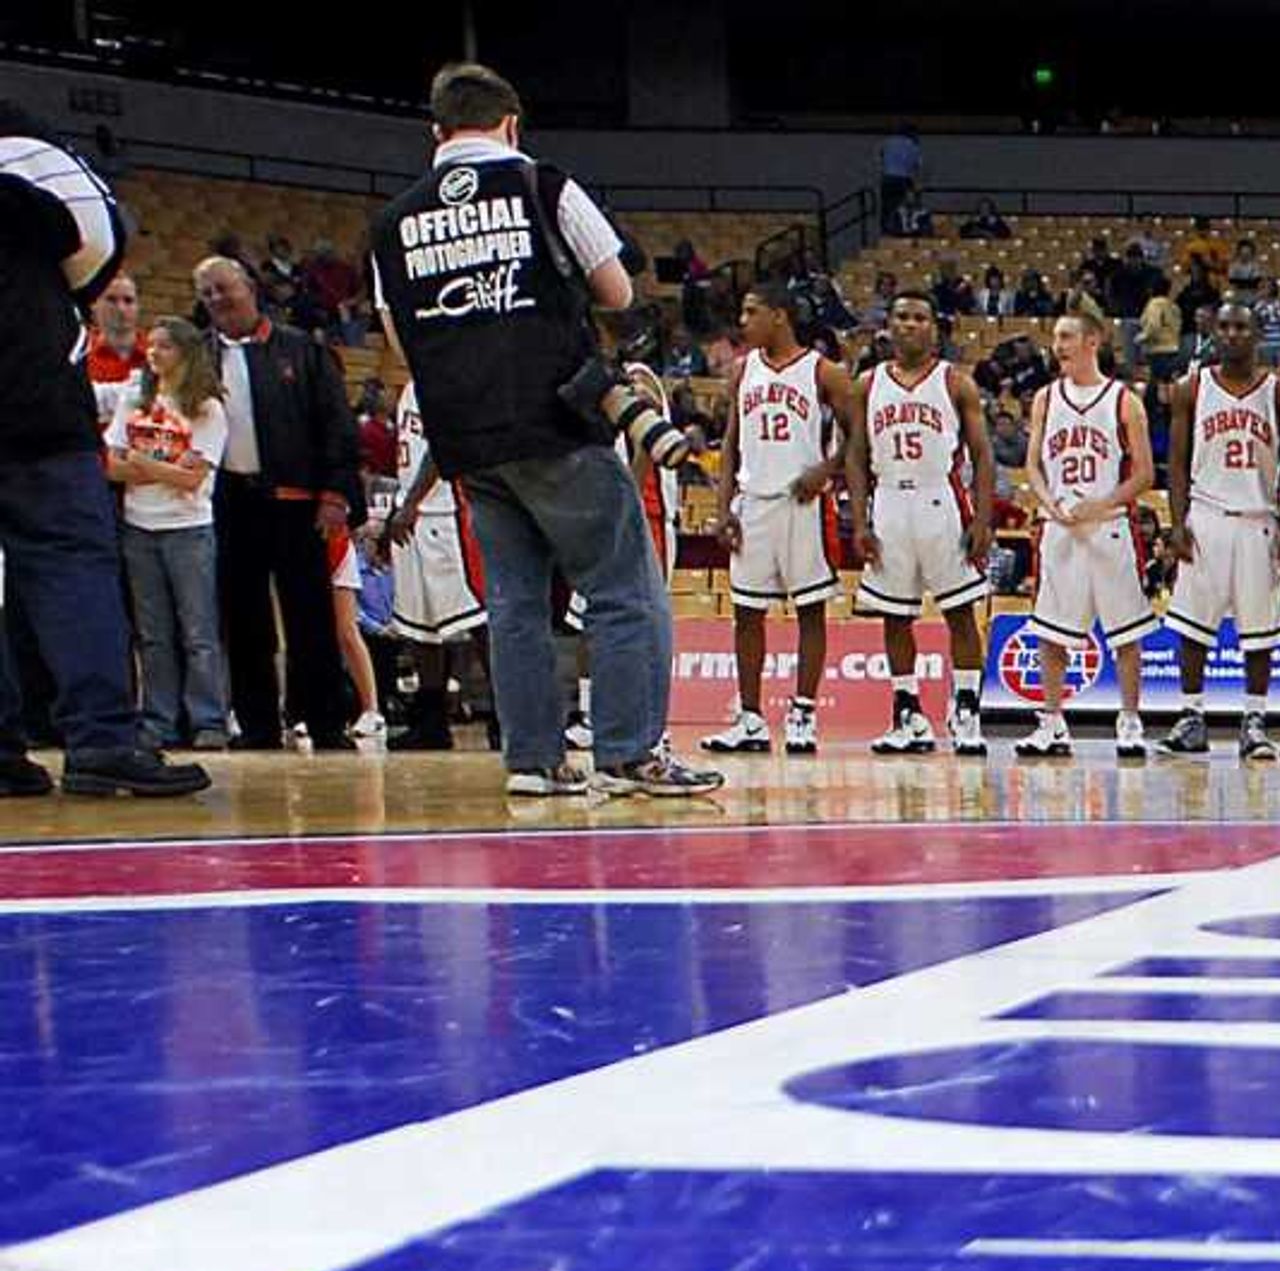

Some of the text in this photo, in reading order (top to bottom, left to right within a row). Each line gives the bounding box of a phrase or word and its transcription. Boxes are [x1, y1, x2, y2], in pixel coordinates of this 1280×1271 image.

[400, 197, 531, 248] OFFICIAL
[405, 230, 533, 280] PHOTOGRAPHER
[743, 383, 809, 421] BRAVES
[761, 413, 790, 441] 12
[873, 403, 942, 436] BRAVES
[1204, 411, 1271, 443] BRAVES
[893, 431, 923, 461] 15
[1225, 440, 1255, 469] 21
[1061, 455, 1097, 485] 20
